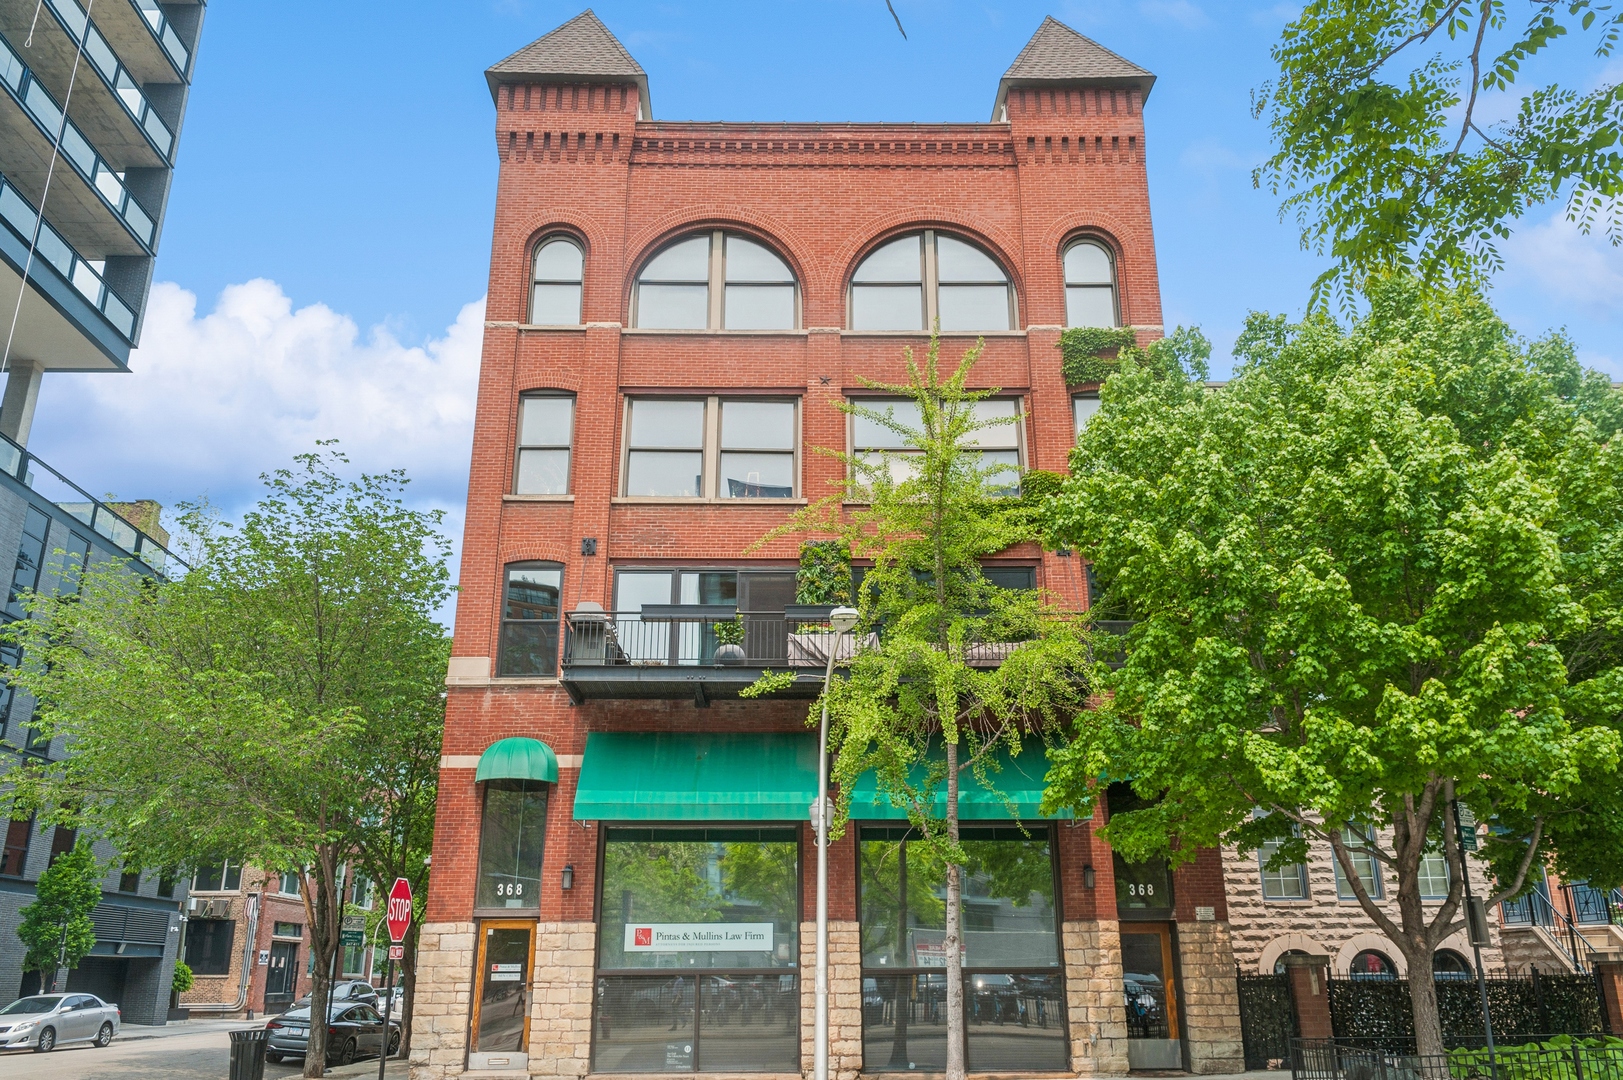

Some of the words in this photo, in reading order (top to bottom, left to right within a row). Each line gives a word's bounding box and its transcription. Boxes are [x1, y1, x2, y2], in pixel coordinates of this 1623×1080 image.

[497, 883, 523, 896] 368
[1129, 883, 1154, 896] 368
[389, 898, 411, 922] STOP
[656, 931, 681, 941] Pintas
[682, 932, 690, 941] &
[692, 931, 723, 941] Mullins
[725, 931, 742, 940] Law
[744, 931, 765, 940] Firm
